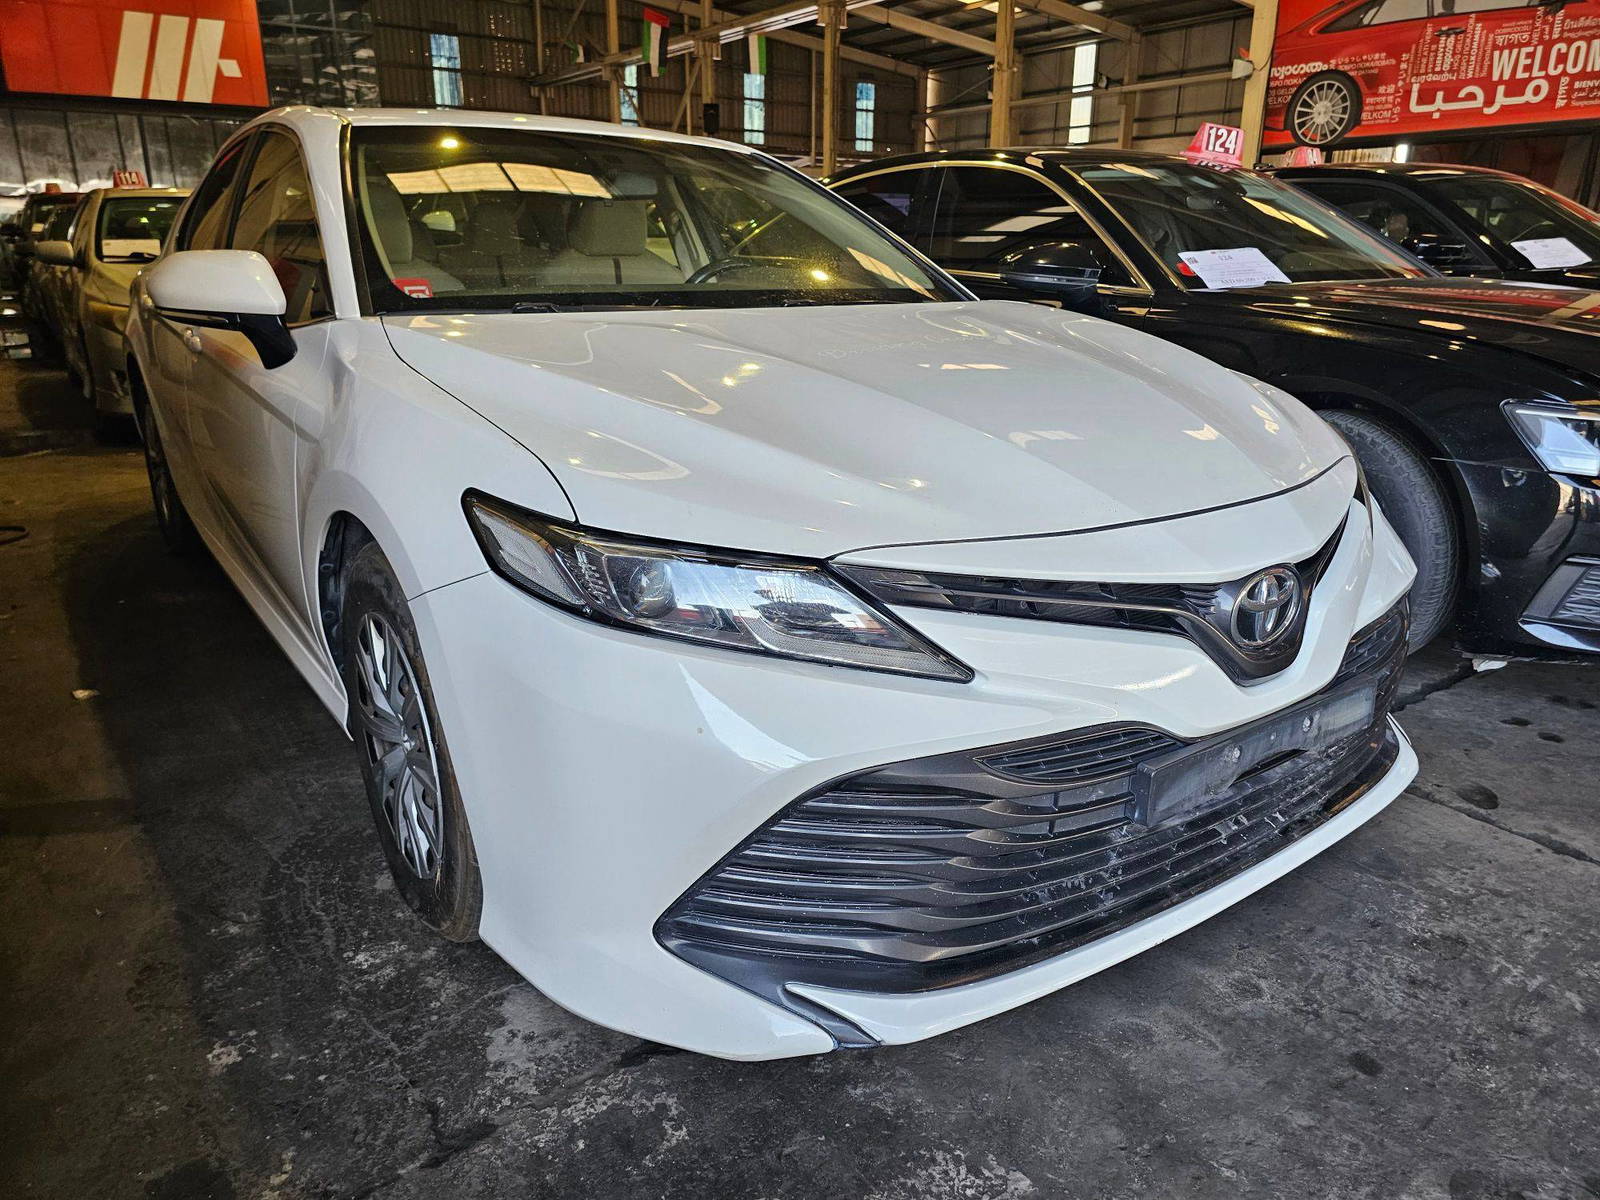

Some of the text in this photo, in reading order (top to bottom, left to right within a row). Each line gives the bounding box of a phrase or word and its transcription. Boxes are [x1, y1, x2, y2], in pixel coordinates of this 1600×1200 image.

[1409, 78, 1549, 119] مرحبا
[1208, 127, 1238, 155] 124
[119, 172, 138, 185] 114
